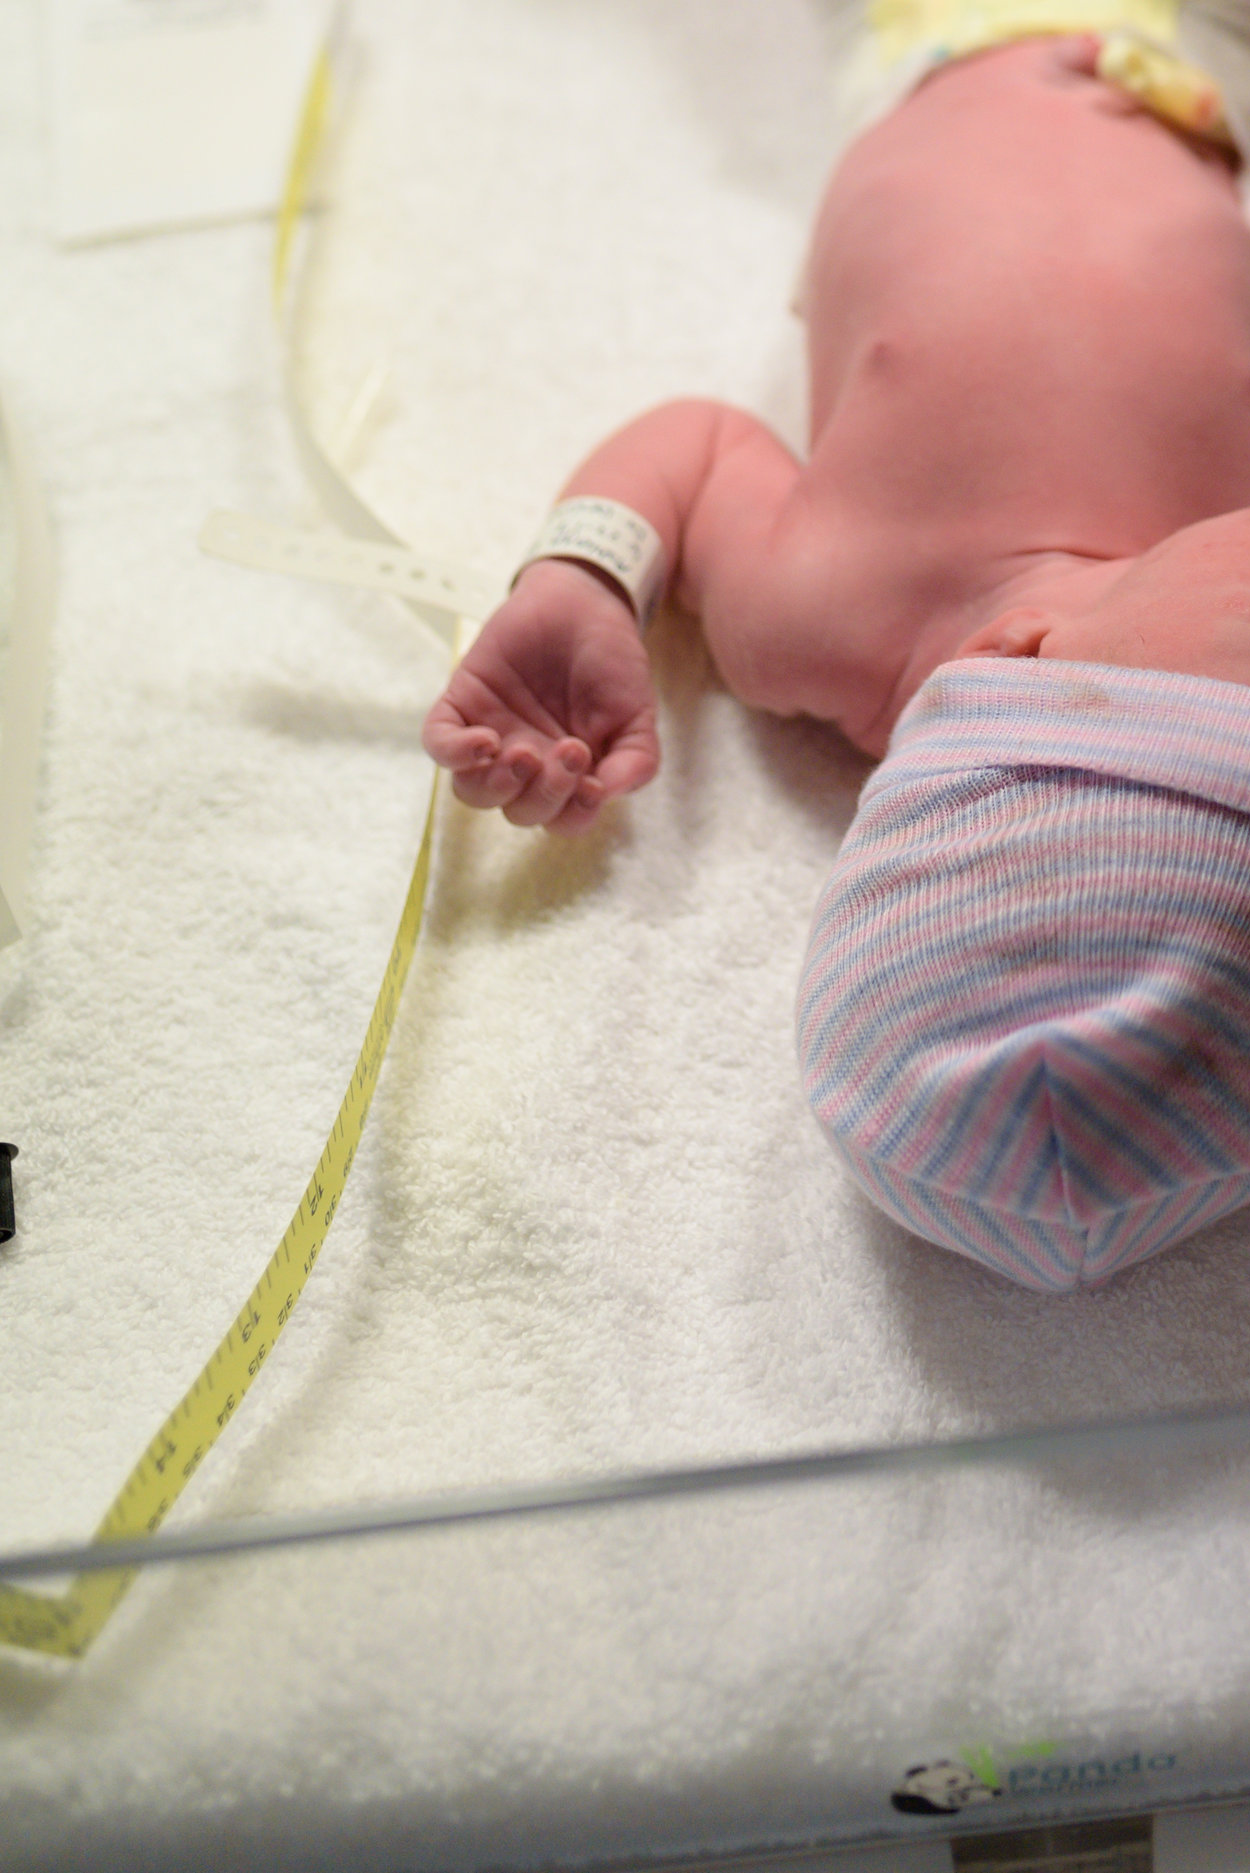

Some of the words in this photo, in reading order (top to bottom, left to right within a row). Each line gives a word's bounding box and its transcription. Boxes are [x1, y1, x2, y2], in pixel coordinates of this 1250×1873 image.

[309, 1184, 324, 1217] 12
[324, 1194, 337, 1226] 30
[303, 1243, 316, 1274] 31
[277, 1293, 293, 1326] 32
[241, 1310, 261, 1344] 13
[248, 1343, 266, 1376] 33
[217, 1394, 235, 1427] 34
[1009, 1750, 1177, 1792] Panda
